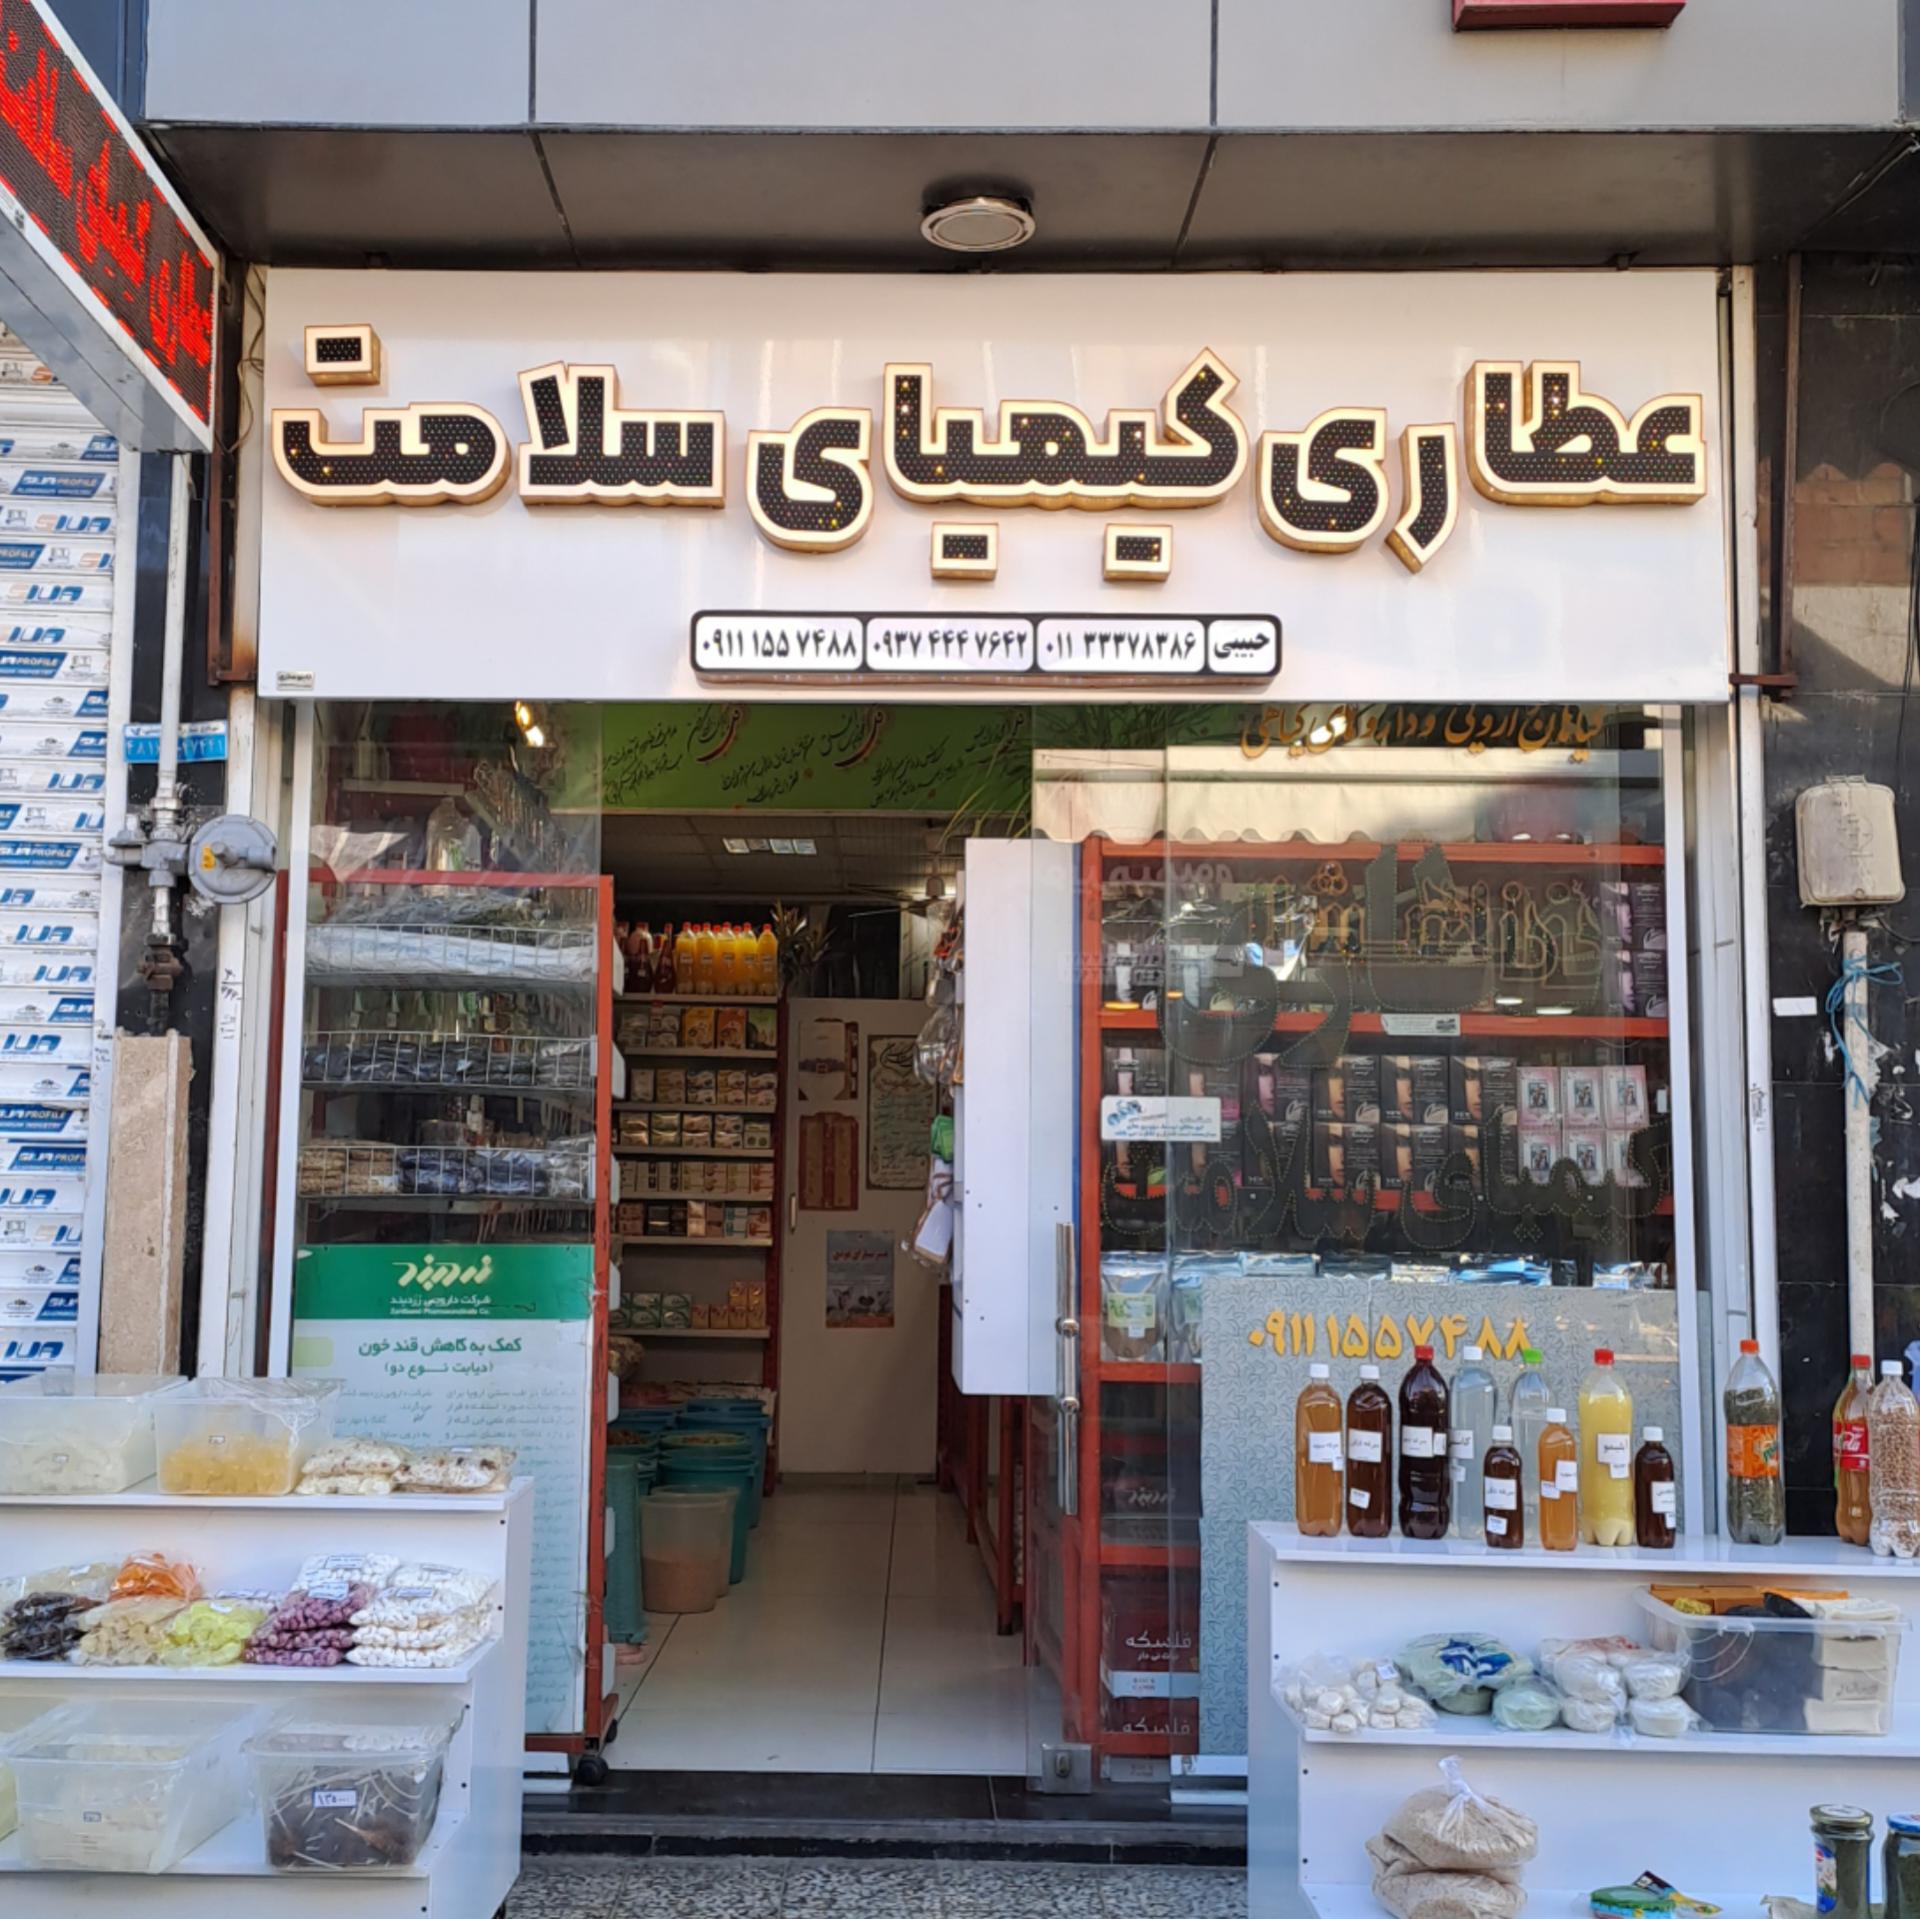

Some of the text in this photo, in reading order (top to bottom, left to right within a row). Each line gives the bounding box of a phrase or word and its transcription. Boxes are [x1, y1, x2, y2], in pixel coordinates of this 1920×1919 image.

[272, 324, 1705, 585] عطاری کیمیای سلامت
[703, 629, 857, 657] ۰۹۱۱ ۱۵۵ ۷۴۸۸
[873, 630, 1027, 658] ۰۹۳۷ ۴۴۴ ۷۶۴۲
[1046, 632, 1196, 659] ۰۱۱ ۳۳۳۷۸۳۸۶
[1214, 632, 1270, 659] حبیبی
[359, 1336, 522, 1357] کمک به کاهش قند خون
[1249, 1310, 1316, 1357] ۰۹۱۱
